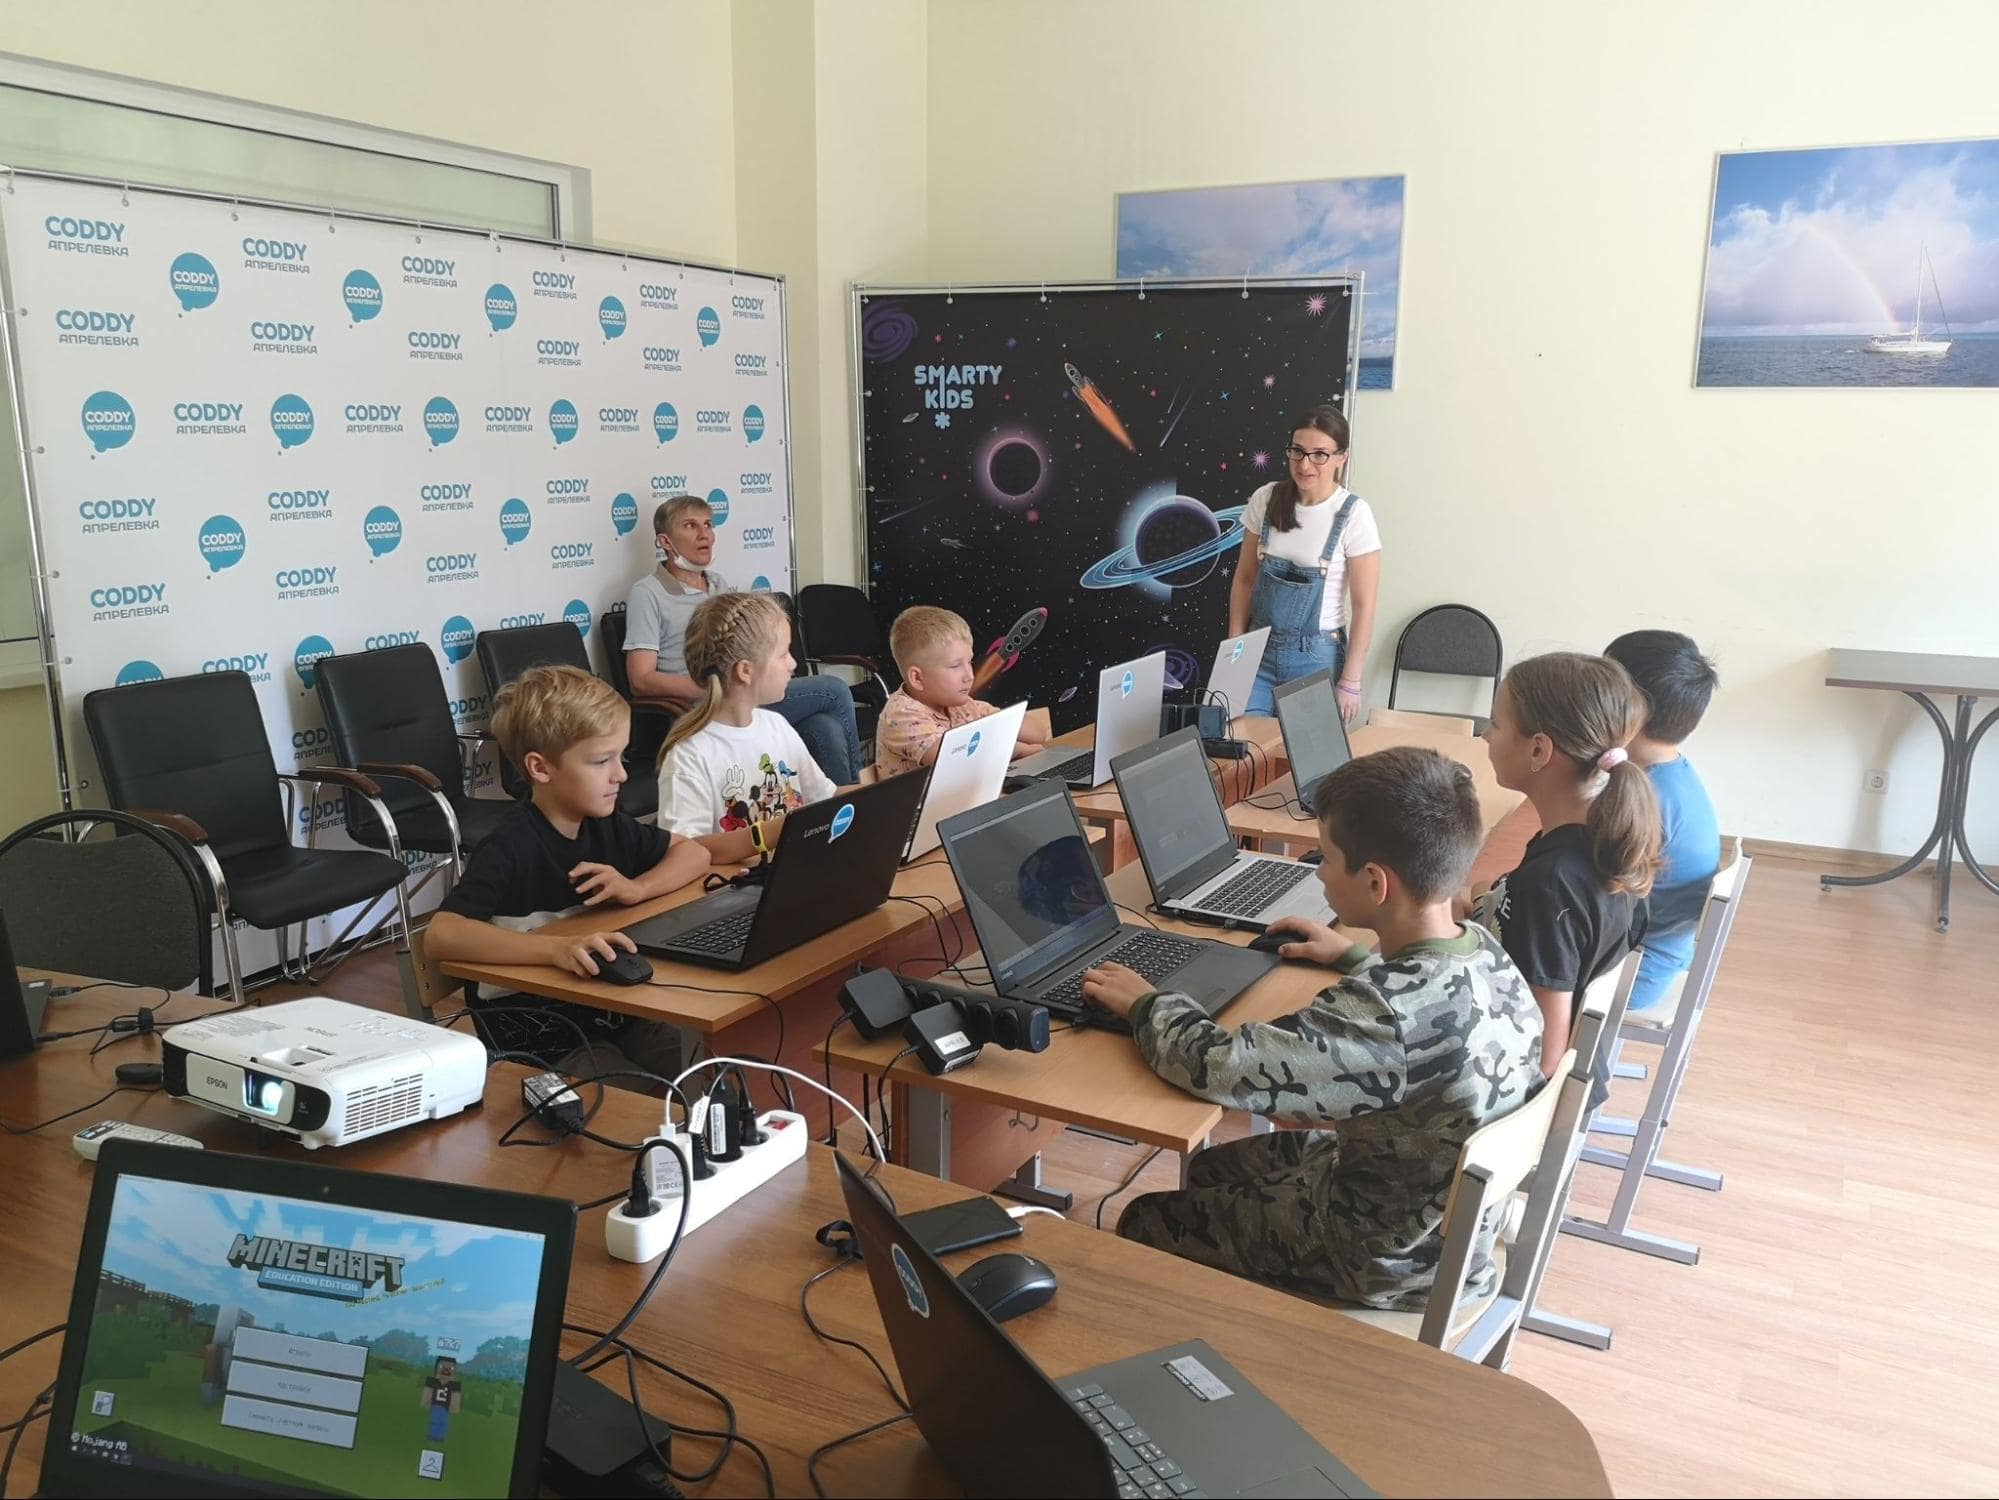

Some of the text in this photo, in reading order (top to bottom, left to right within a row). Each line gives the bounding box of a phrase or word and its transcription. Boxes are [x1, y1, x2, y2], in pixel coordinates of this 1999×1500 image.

[45, 216, 125, 242] CODDY
[48, 240, 129, 257] АПРЕЛЕВКА
[242, 237, 307, 260] CODDY
[245, 259, 311, 274] АПРЕЛЕВКА
[402, 255, 456, 277] CODDY
[173, 271, 216, 285] CODDY
[403, 273, 458, 289] АПРЕЛЕВКА
[532, 270, 576, 290] CODDY
[345, 285, 380, 298] CODDY
[639, 284, 677, 301] CODDY
[487, 298, 515, 310] CODDY
[731, 295, 764, 312] CODDY
[56, 309, 136, 333] CODDY
[600, 309, 626, 320] CODDY
[251, 321, 315, 342] CODDY
[59, 333, 139, 347] АПРЕЛЕВКА
[408, 331, 461, 351] CODDY
[253, 342, 318, 354] АПРЕЛЕВКА
[410, 349, 463, 362] АПРЕЛЕВКА
[536, 339, 580, 357] CODDY
[643, 347, 680, 362] CODDY
[734, 353, 767, 368] CODDY
[914, 365, 1002, 386] SMARTY
[925, 388, 974, 409] KIDS
[85, 409, 133, 424] CODDY
[173, 402, 243, 421] CODDY
[273, 411, 312, 422] CODDY
[344, 404, 402, 422] CODDY
[426, 412, 458, 423] CODDY
[485, 406, 532, 422] CODDY
[599, 408, 639, 423] CODDY
[696, 410, 730, 424] CODDY
[176, 423, 246, 435] АПРЕЛЕВКА
[346, 424, 404, 433] АПРЕЛЕВКА
[546, 479, 589, 495] CODDY
[651, 475, 687, 490] CODDY
[740, 472, 772, 487] CODDY
[267, 489, 330, 510] CODDY
[420, 483, 472, 501] CODDY
[79, 498, 156, 521] CODDY
[269, 509, 333, 522] АПРЕЛЕВКА
[501, 512, 529, 523] CODDY
[82, 520, 160, 535] АПРЕЛЕВКА
[365, 521, 400, 533] CODDY
[742, 527, 774, 541] CODDY
[201, 532, 242, 546] CODDY
[551, 542, 593, 560] CODDY
[426, 553, 477, 573] CODDY
[275, 566, 337, 589] CODDY
[427, 569, 479, 583] АПРЕЛЕВКА
[90, 583, 166, 608] CODDY
[278, 585, 340, 600] АПРЕЛЕВКА
[93, 604, 170, 622] АПРЕЛЕВКА
[443, 629, 473, 641] CODDY
[207, 1076, 228, 1089] EPSON
[227, 1233, 405, 1292] MINECRAFT
[319, 1278, 359, 1292] EDITION
[82, 1434, 114, 1449] Mojang
